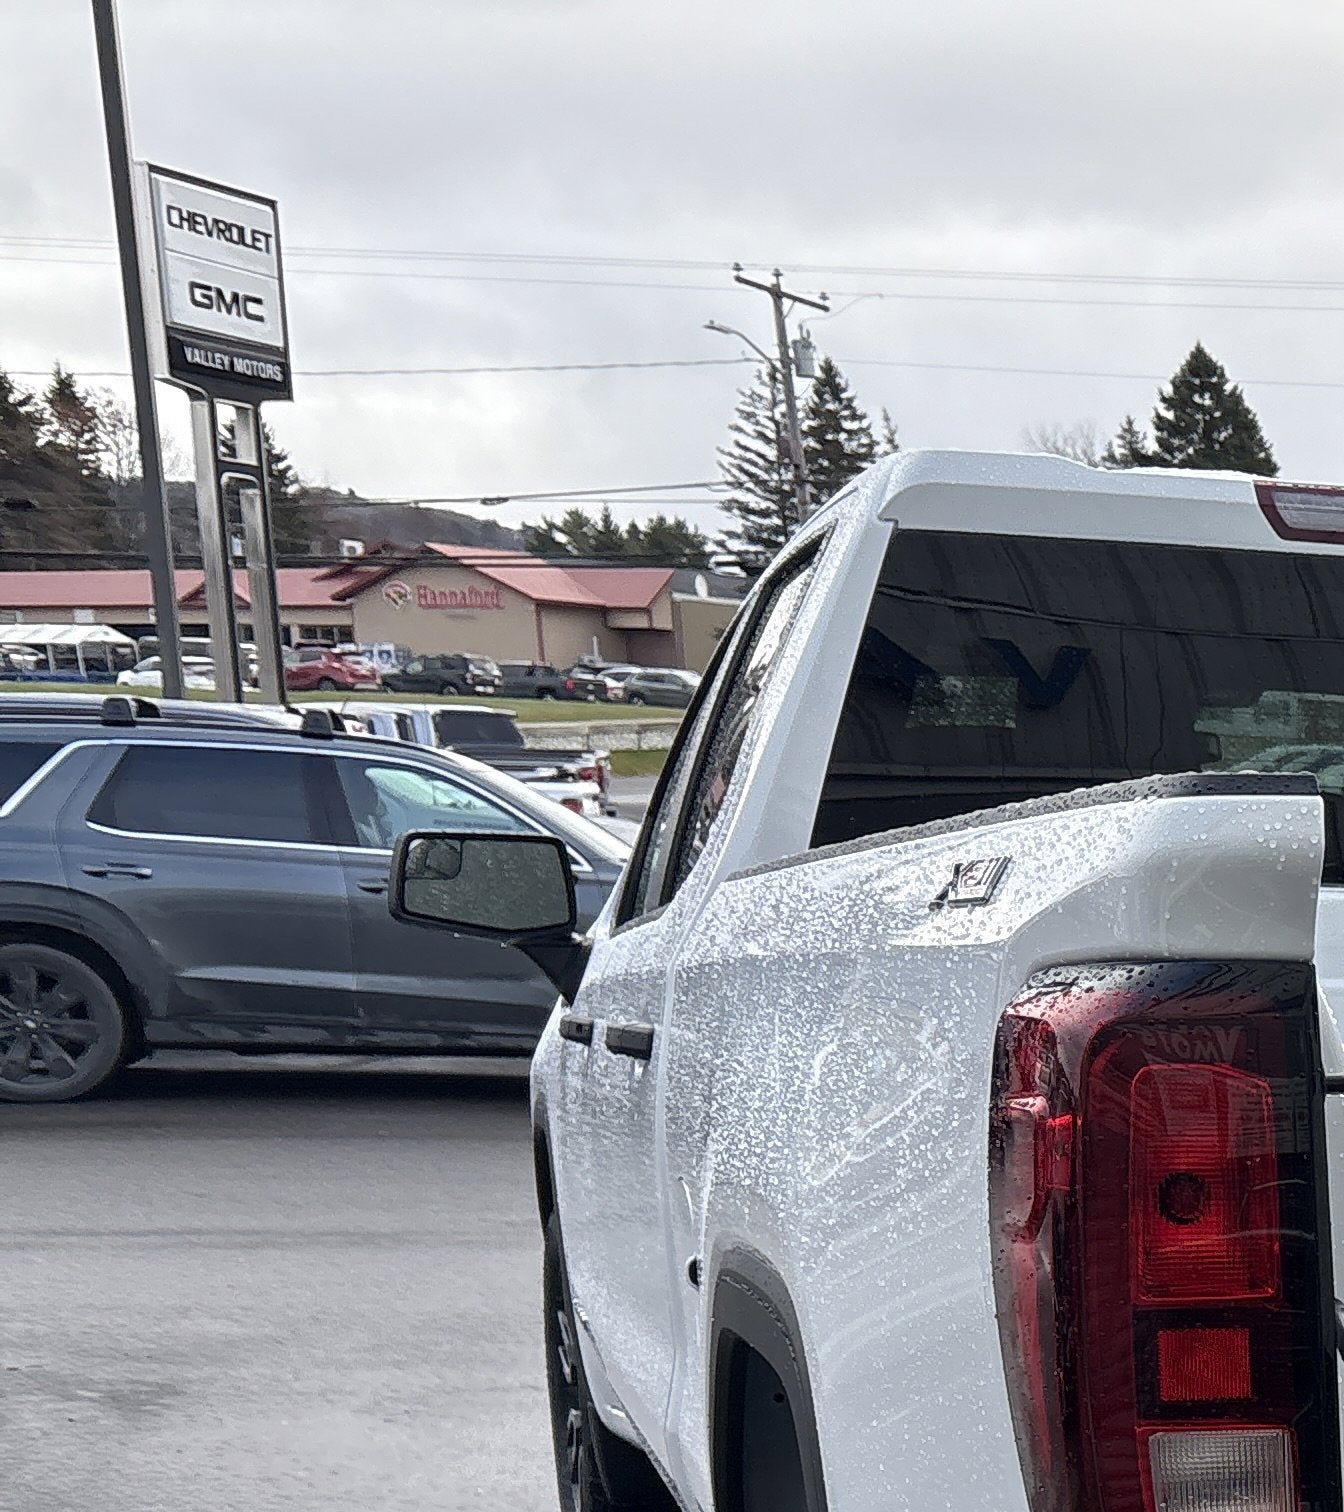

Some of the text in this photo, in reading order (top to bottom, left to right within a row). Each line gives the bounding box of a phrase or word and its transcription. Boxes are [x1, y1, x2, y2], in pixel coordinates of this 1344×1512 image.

[166, 204, 273, 255] CHEVROLET
[188, 280, 265, 323] GMC
[183, 345, 284, 382] VALLEY MOTORS
